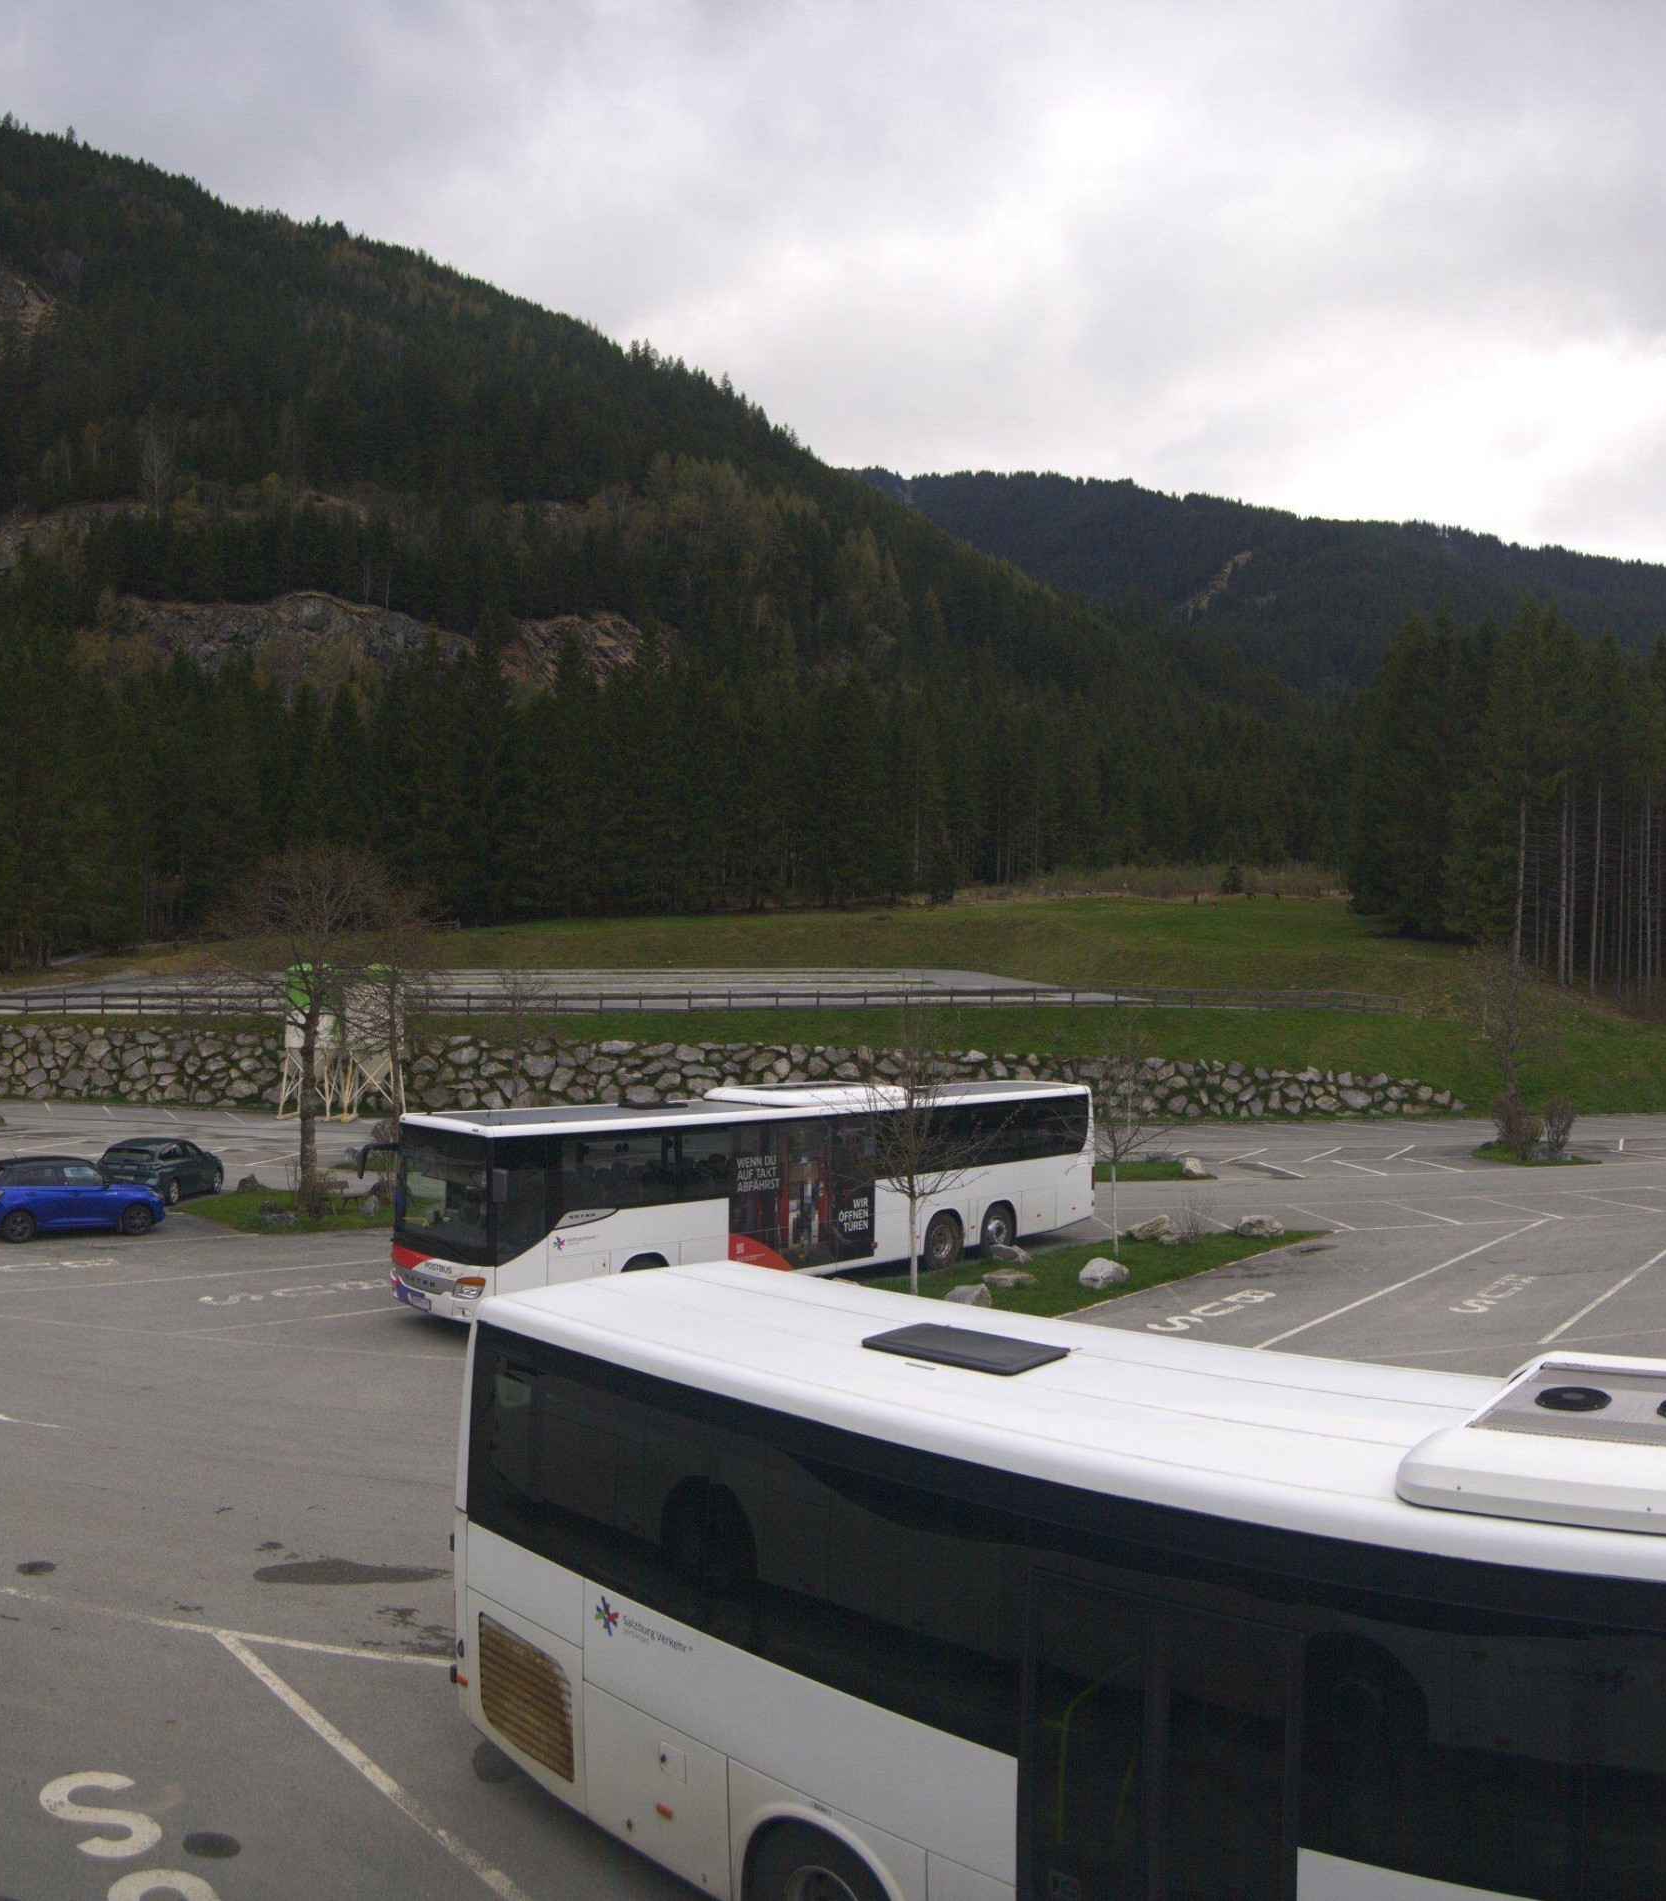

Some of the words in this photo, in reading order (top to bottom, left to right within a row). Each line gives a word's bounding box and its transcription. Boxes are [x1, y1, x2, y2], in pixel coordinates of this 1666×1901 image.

[736, 1156, 763, 1169] WENN
[764, 1154, 777, 1166] DU
[736, 1168, 755, 1181] AUF
[755, 1166, 777, 1178] TAKT
[852, 1197, 869, 1209] WIR
[838, 1209, 869, 1223] ÖFFNEN
[842, 1218, 869, 1233] TÜREN
[424, 1261, 454, 1275] POSTBUS
[1146, 1288, 1278, 1332] BUS
[622, 1615, 655, 1641] Salzburg
